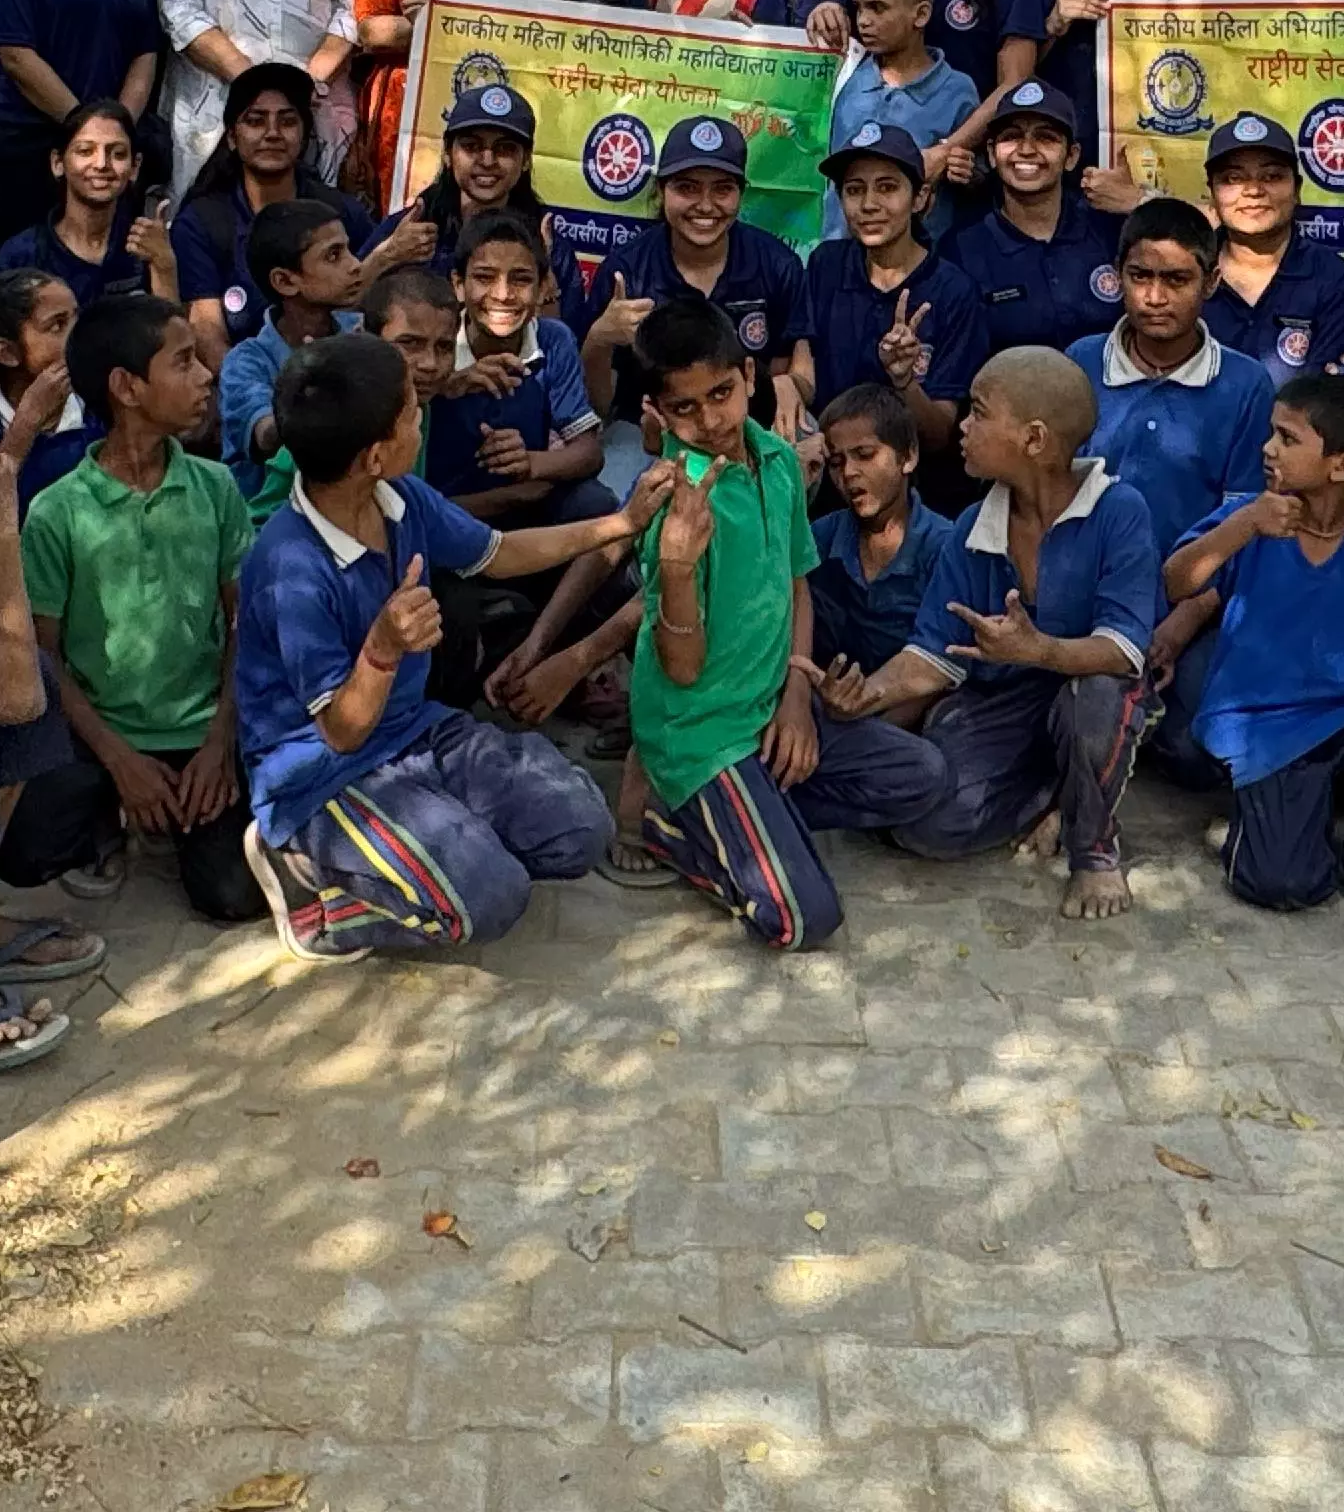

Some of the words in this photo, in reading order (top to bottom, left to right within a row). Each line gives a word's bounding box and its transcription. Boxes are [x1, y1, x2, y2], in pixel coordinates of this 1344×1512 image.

[441, 14, 509, 42] राजकीय
[513, 20, 567, 52] महिला
[572, 28, 673, 64] अभियांत्रिकी
[678, 44, 778, 78] महाविद्यालय
[1124, 12, 1196, 40] राजकीय
[1201, 11, 1261, 43] महिला
[1245, 49, 1309, 88] राष्ट्रीय
[655, 72, 722, 110] योजना
